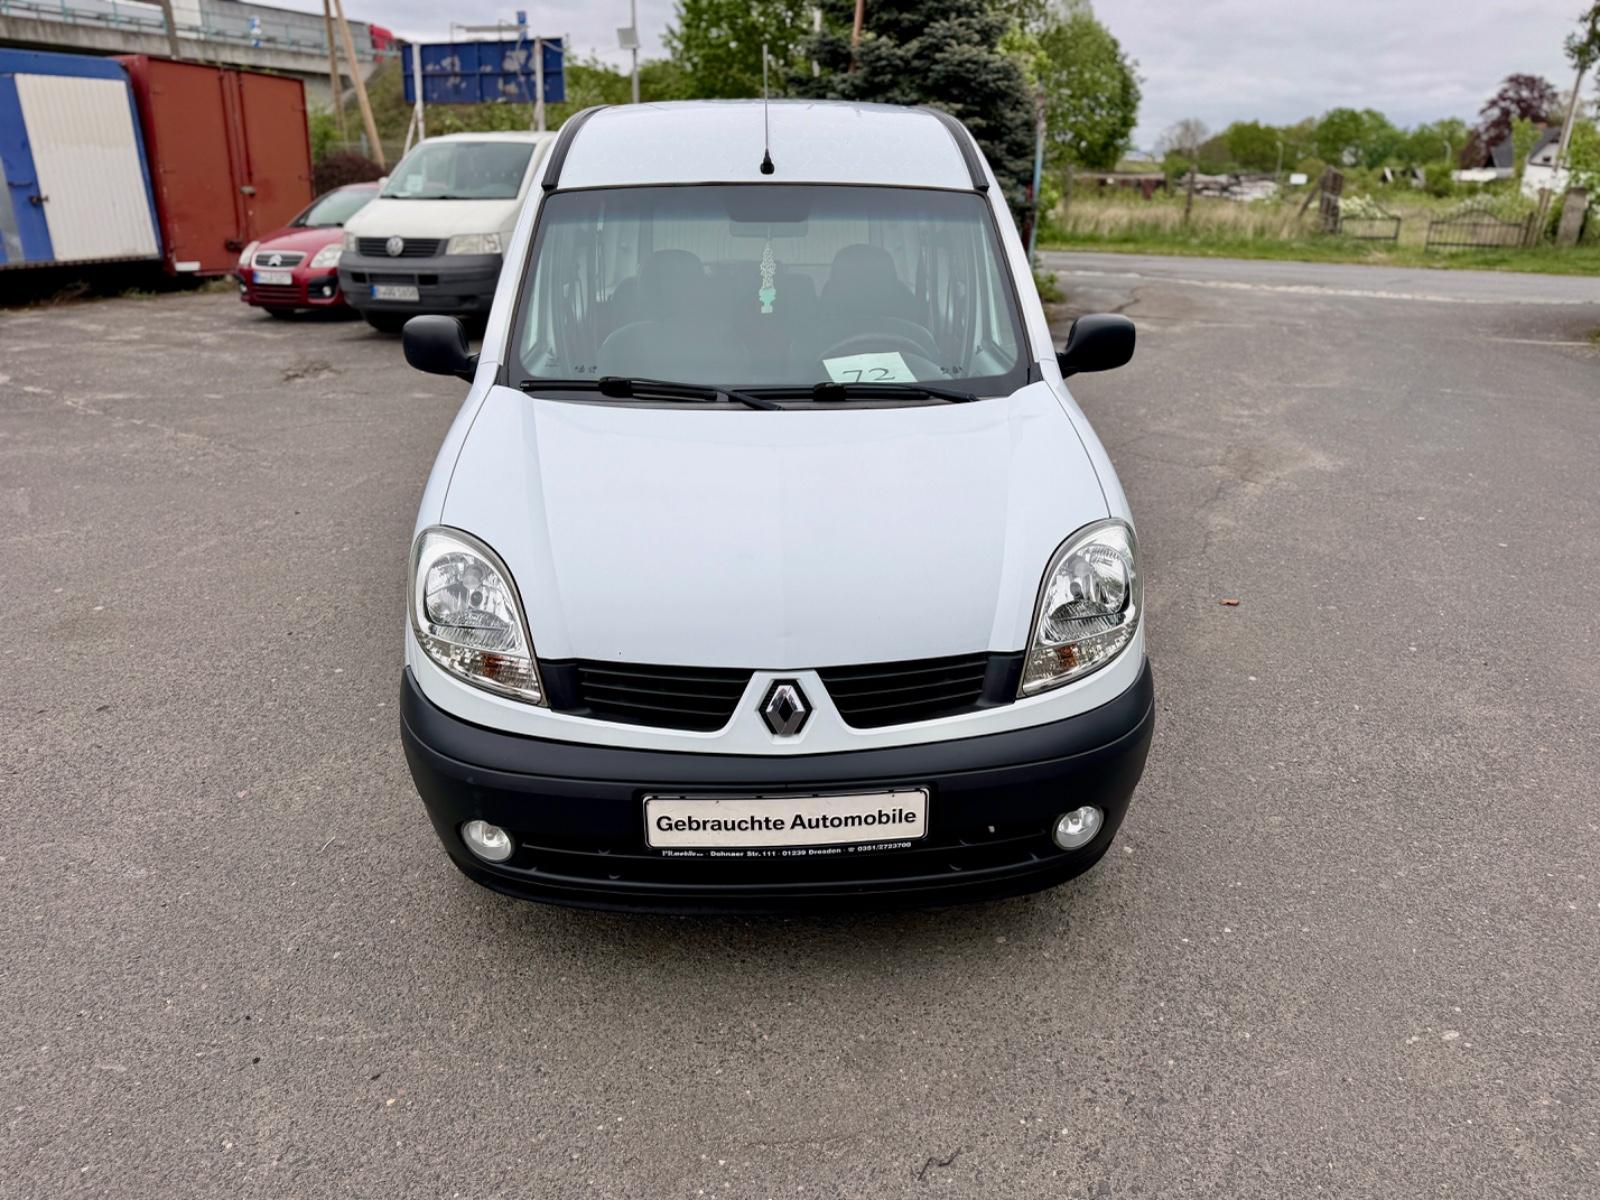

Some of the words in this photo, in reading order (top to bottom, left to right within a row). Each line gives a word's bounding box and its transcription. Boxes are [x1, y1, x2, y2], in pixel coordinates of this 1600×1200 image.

[842, 367, 896, 383] 72
[656, 815, 785, 832] Gebrauchte
[790, 808, 917, 830] Automobile
[782, 849, 807, 857] 01239
[808, 848, 842, 856] Dresden
